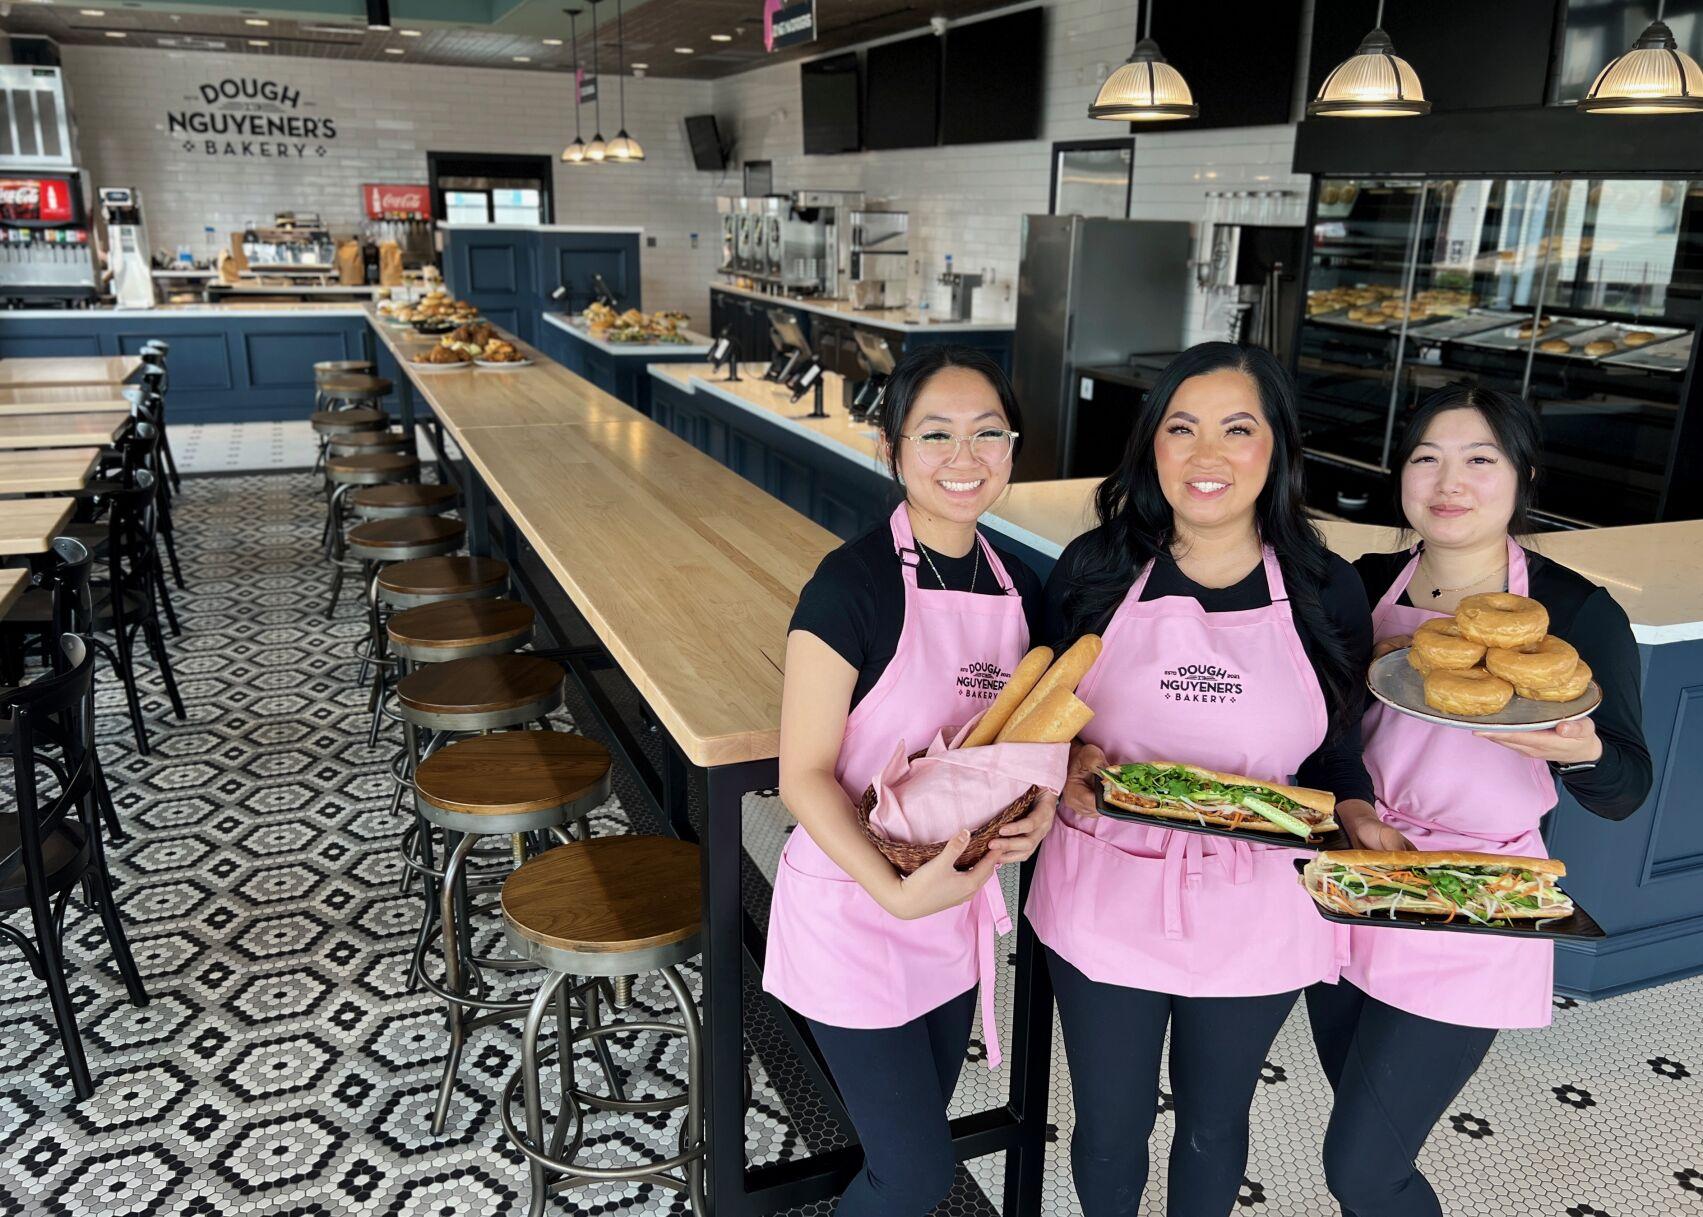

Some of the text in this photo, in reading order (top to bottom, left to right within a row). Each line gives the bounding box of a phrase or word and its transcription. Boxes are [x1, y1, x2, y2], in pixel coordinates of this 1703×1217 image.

[200, 78, 300, 109] DOUGH
[168, 111, 337, 139] NGUYENER'S
[205, 140, 306, 157] BAKERY
[382, 193, 421, 209] Coca-Cola
[969, 662, 1001, 677] DOUGH
[1178, 664, 1227, 680] DOUGH
[956, 676, 1007, 691] NGUYENER'
[1160, 679, 1243, 695] NGUYENER'S
[965, 690, 999, 700] BAKERY
[1175, 693, 1226, 703] BAKERY
